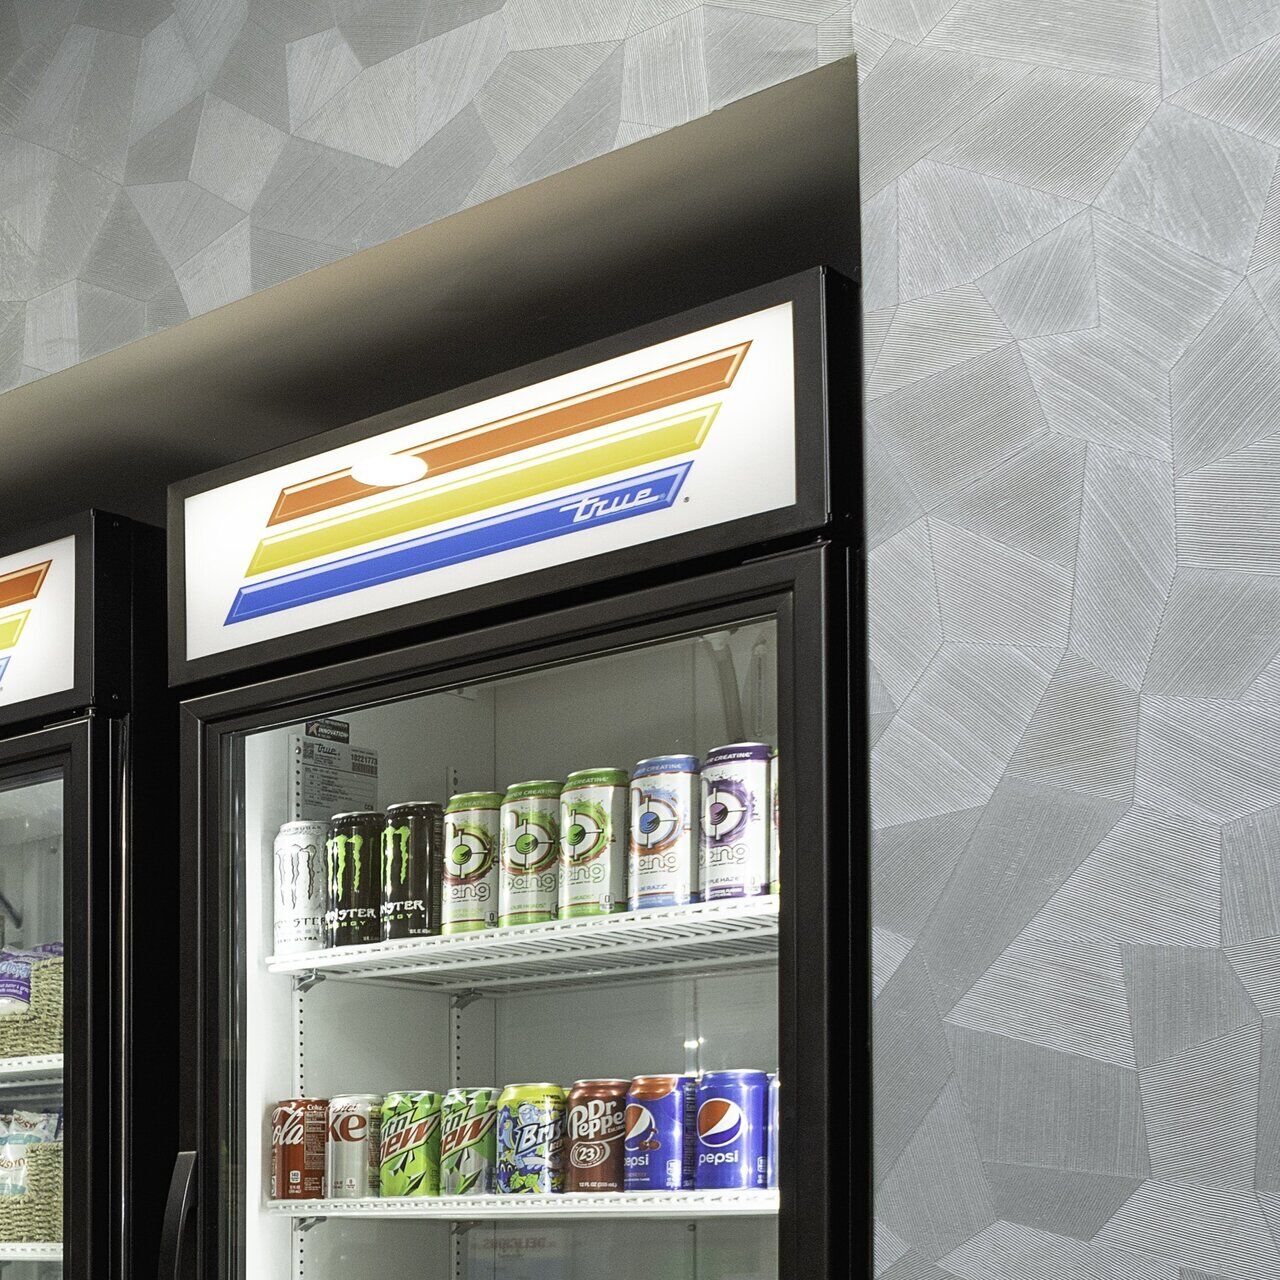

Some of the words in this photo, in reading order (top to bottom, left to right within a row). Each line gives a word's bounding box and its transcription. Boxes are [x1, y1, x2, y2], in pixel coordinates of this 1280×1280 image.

[380, 900, 426, 916] NSTER
[380, 913, 413, 923] ERGY
[588, 1100, 617, 1121] Dr
[325, 1108, 367, 1142] ke
[568, 1105, 624, 1140] Peppe
[518, 1118, 563, 1150] Bris
[699, 1150, 739, 1166] pepsi
